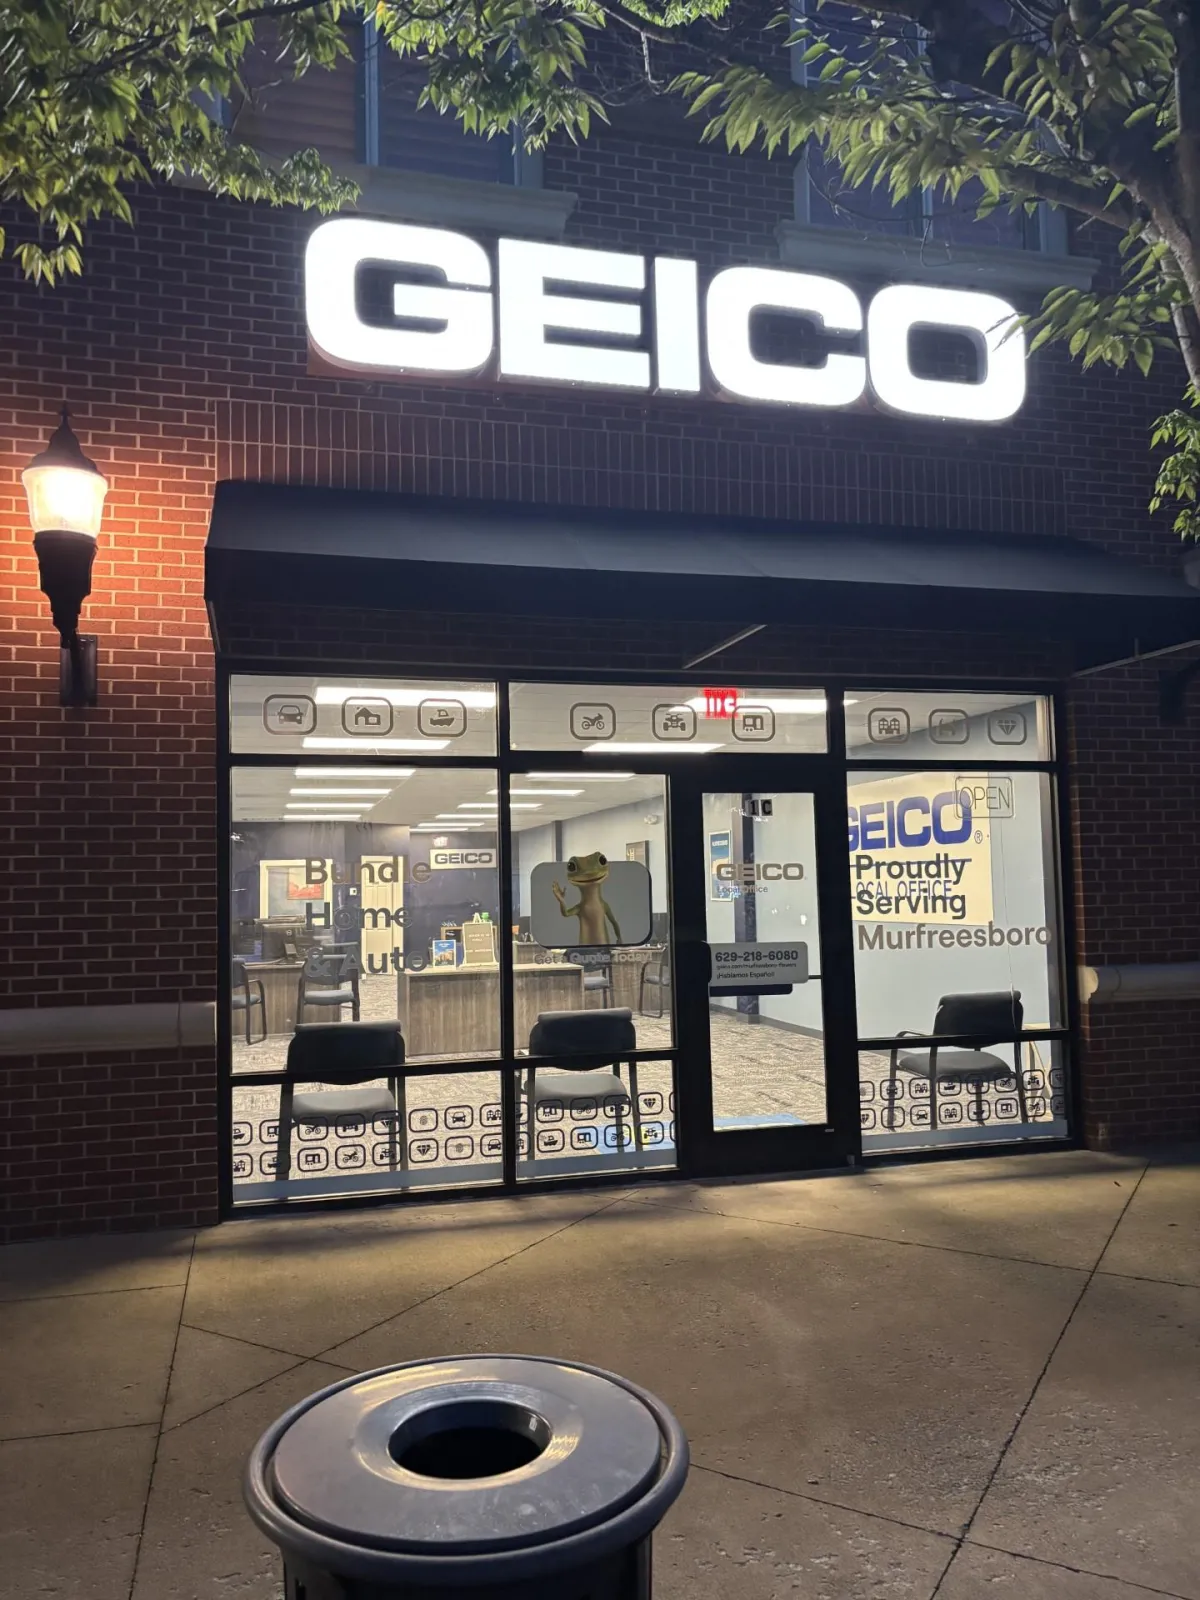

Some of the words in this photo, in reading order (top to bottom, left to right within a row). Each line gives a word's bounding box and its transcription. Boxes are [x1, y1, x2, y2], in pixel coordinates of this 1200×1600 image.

[304, 218, 1027, 422] GEICO
[959, 786, 1011, 810] OPEN
[305, 857, 431, 885] Bundle
[434, 852, 493, 865] GEICO
[716, 862, 804, 881] GEICO
[855, 853, 967, 885] Proudly
[305, 901, 412, 930] Home
[856, 889, 966, 920] Serving
[857, 920, 1051, 951] Murfreesboro
[340, 946, 429, 975] Auto
[715, 950, 799, 962] 629-218-6080
